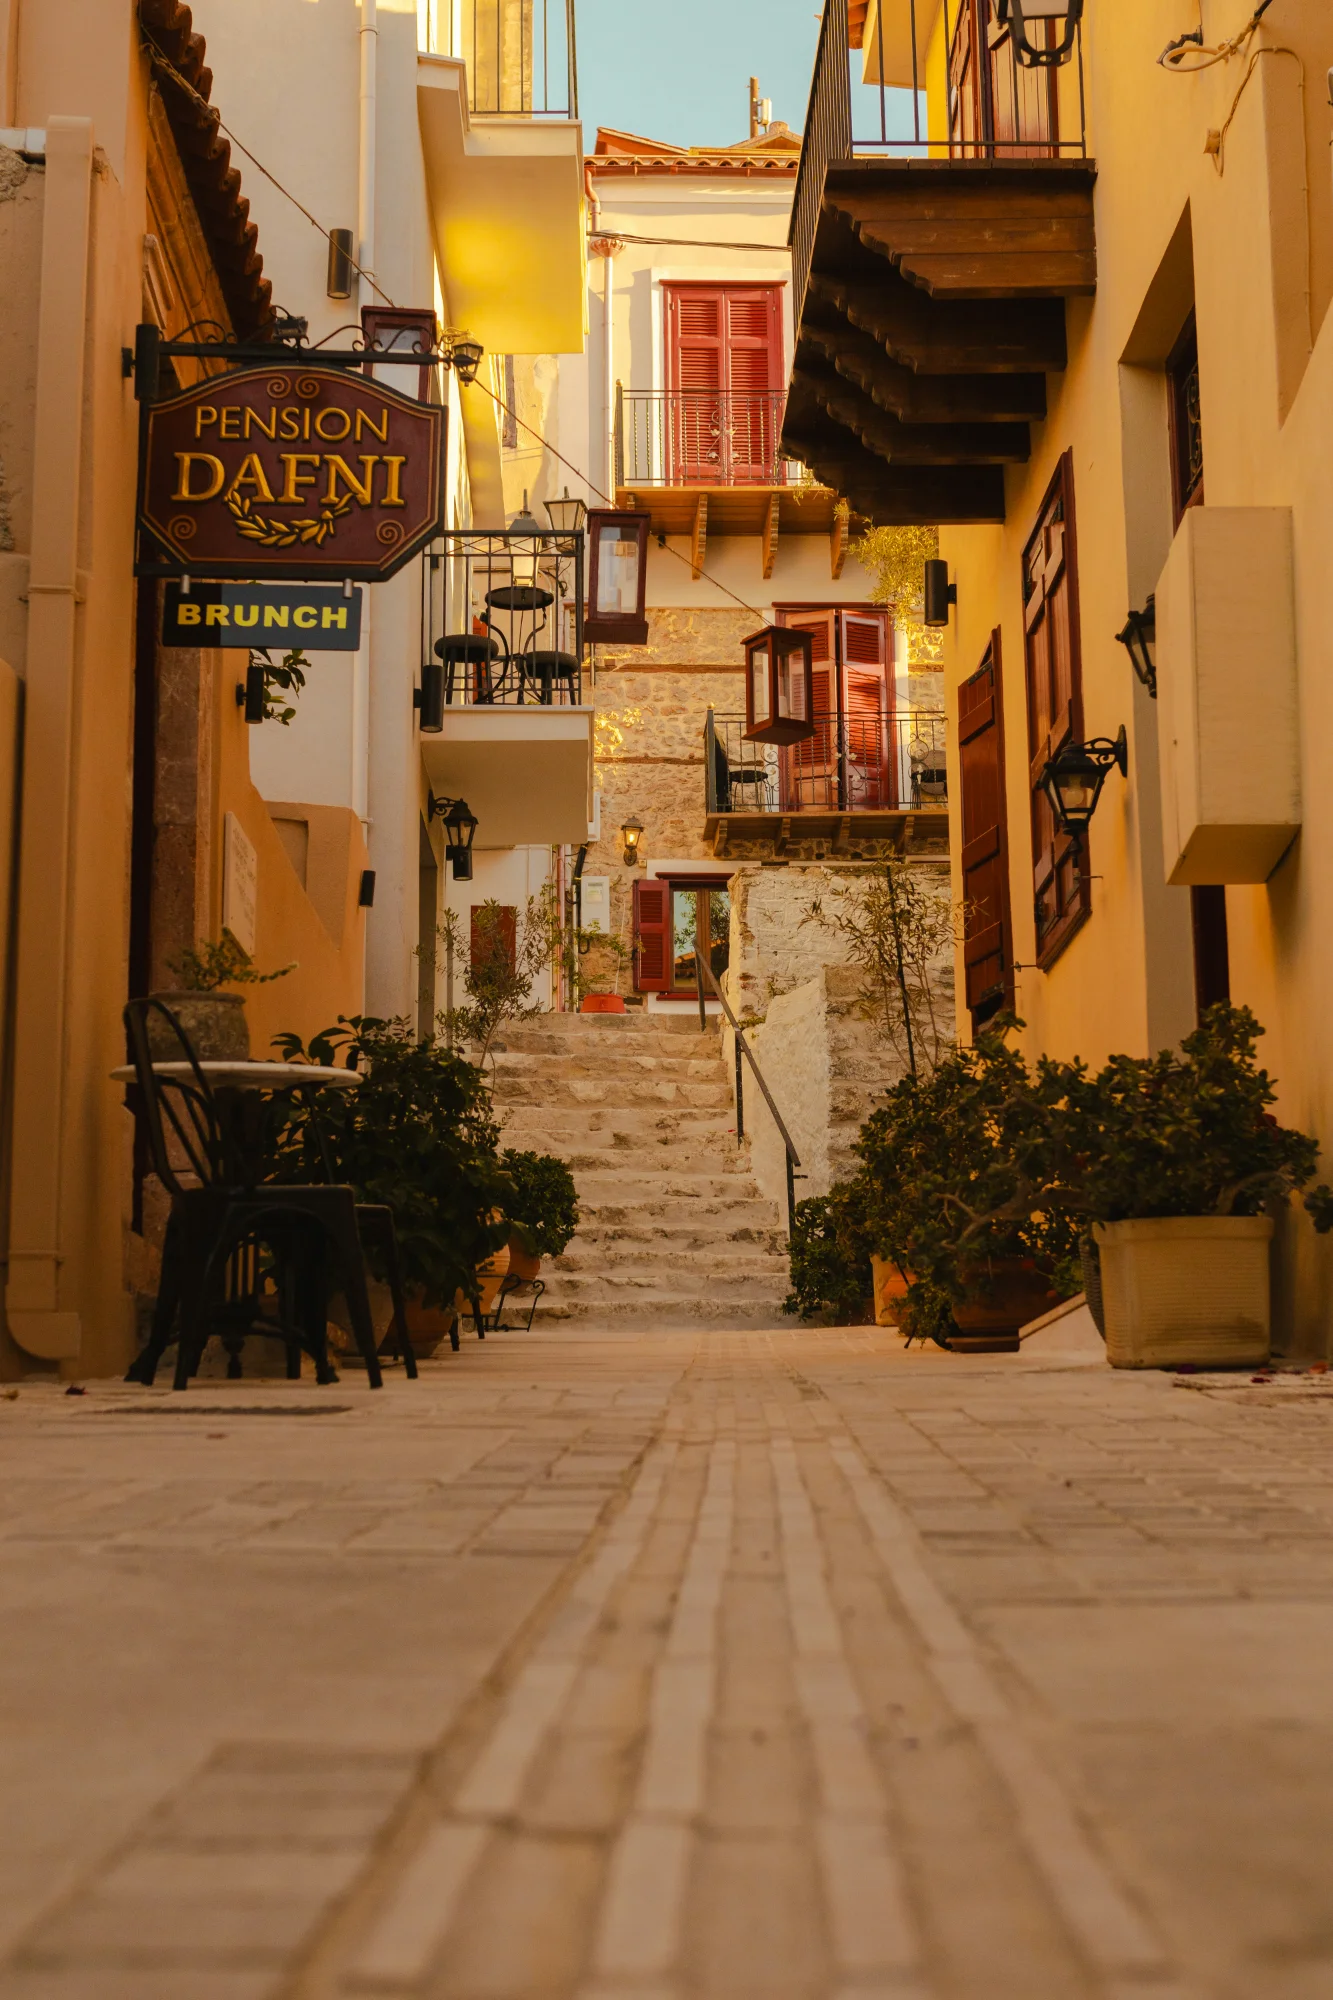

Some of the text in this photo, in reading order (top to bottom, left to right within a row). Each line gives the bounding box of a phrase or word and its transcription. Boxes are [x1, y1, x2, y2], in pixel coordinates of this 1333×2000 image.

[195, 406, 388, 442] PENSION
[171, 452, 406, 507] DAFNI
[177, 603, 348, 629] BRUNCH
